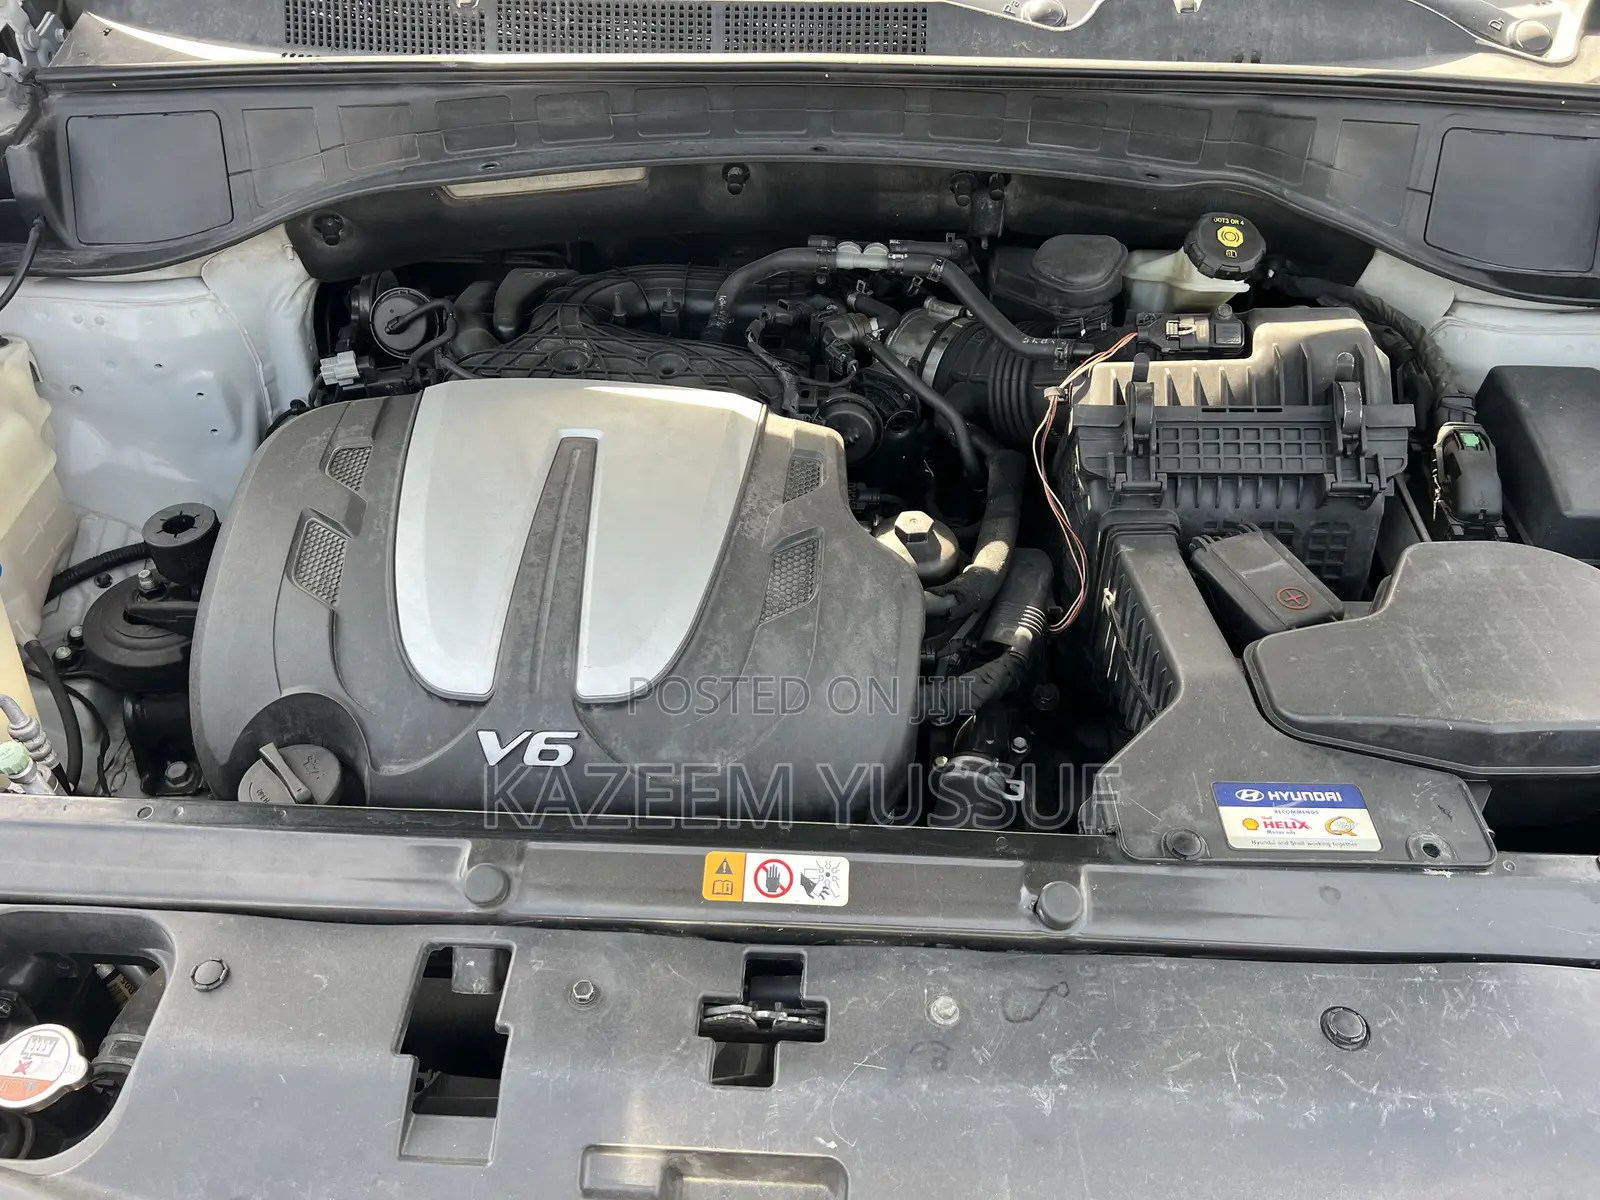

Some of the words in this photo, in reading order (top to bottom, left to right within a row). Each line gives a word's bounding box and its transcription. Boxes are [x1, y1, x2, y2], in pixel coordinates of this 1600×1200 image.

[477, 730, 579, 767] V6
[1268, 790, 1342, 802] HYUNDAI
[1263, 819, 1311, 830] HELIX
[1307, 840, 1331, 848] working
